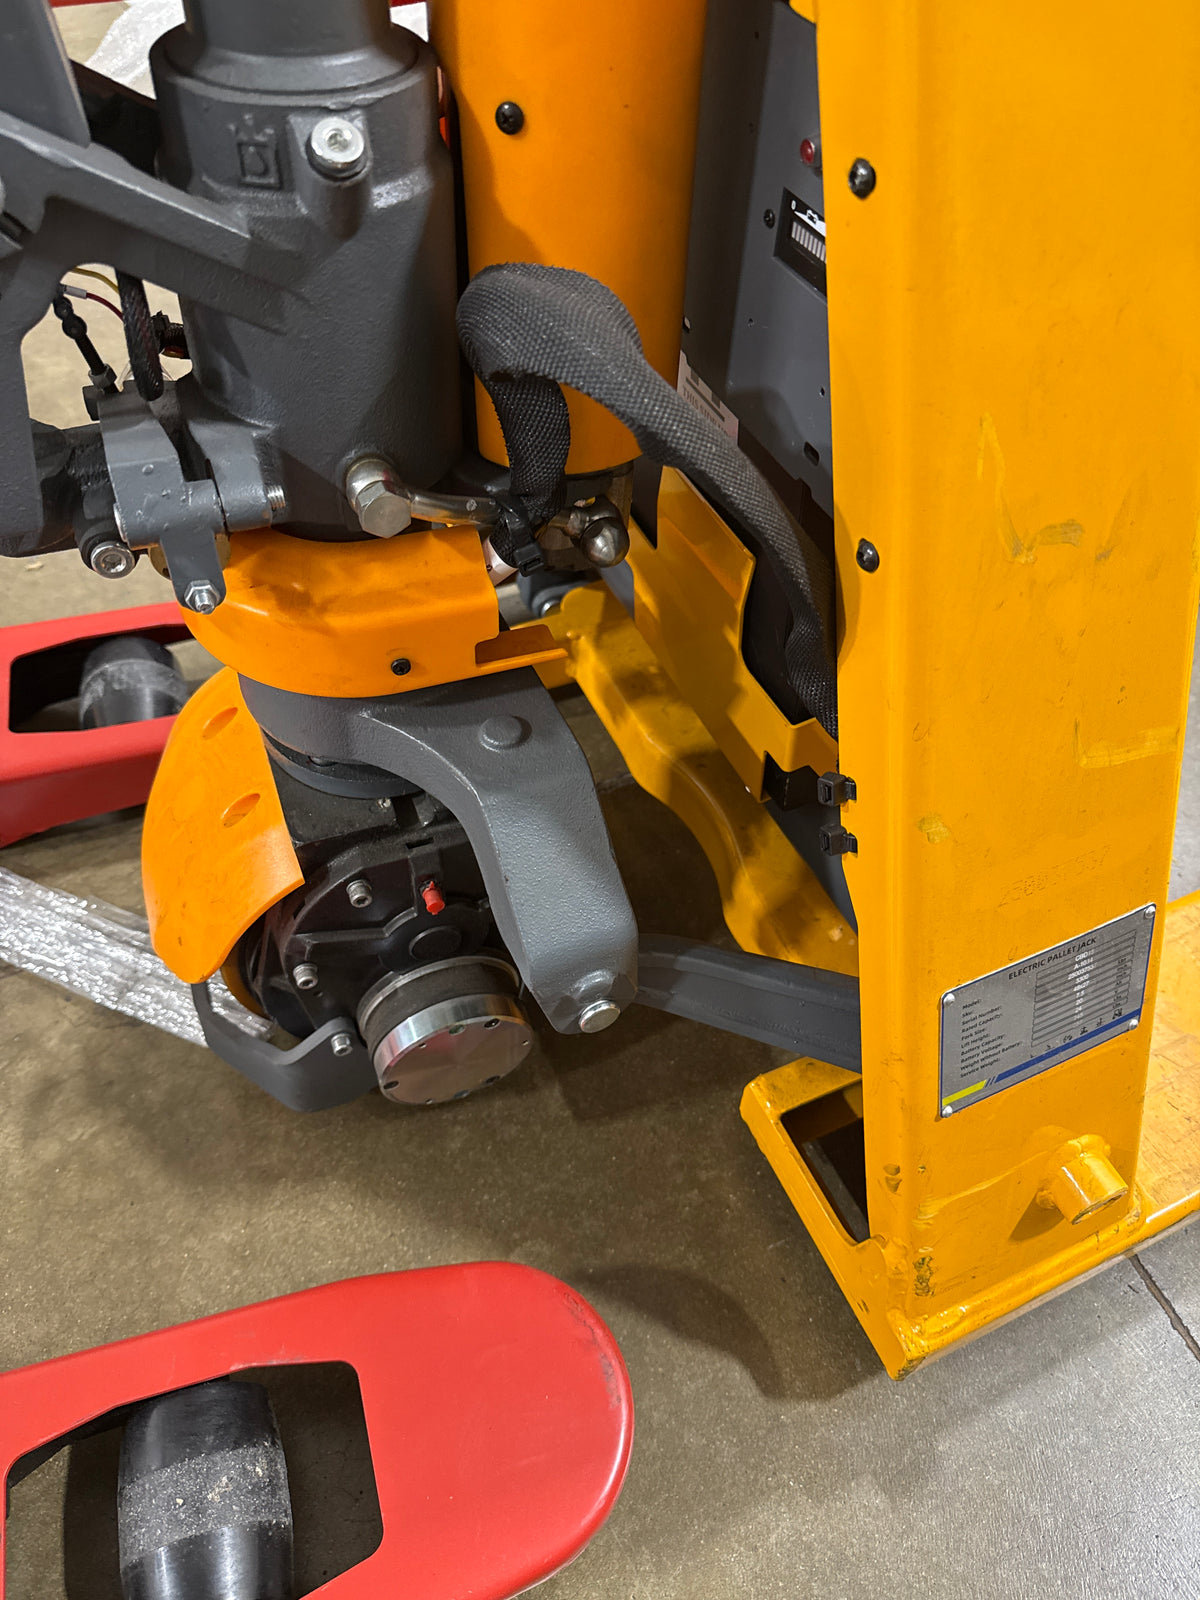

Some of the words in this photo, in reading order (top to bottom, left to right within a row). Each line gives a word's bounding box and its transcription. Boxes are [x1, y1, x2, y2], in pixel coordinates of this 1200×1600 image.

[1008, 960, 1046, 980] ELECTRIC
[1046, 947, 1076, 963] PALLET
[1076, 937, 1097, 952] JACK
[1075, 974, 1089, 984] 3300
[962, 999, 981, 1009] Model:
[962, 1016, 977, 1025] Serial
[978, 1006, 1001, 1018] Number:
[962, 1024, 977, 1033] Rated
[979, 1013, 1003, 1026] Capacity:
[961, 1041, 970, 1049] Lift
[971, 1033, 990, 1044] Height:
[961, 1045, 980, 1056] Battery
[981, 1034, 1005, 1046] Capacity:
[960, 1059, 979, 1071] Weight
[1002, 1041, 1022, 1052] Battery:
[961, 1053, 980, 1063] Battery
[981, 1043, 1002, 1054] Voltage:
[960, 1067, 979, 1078] Service
[980, 1058, 1000, 1069] Weight:
